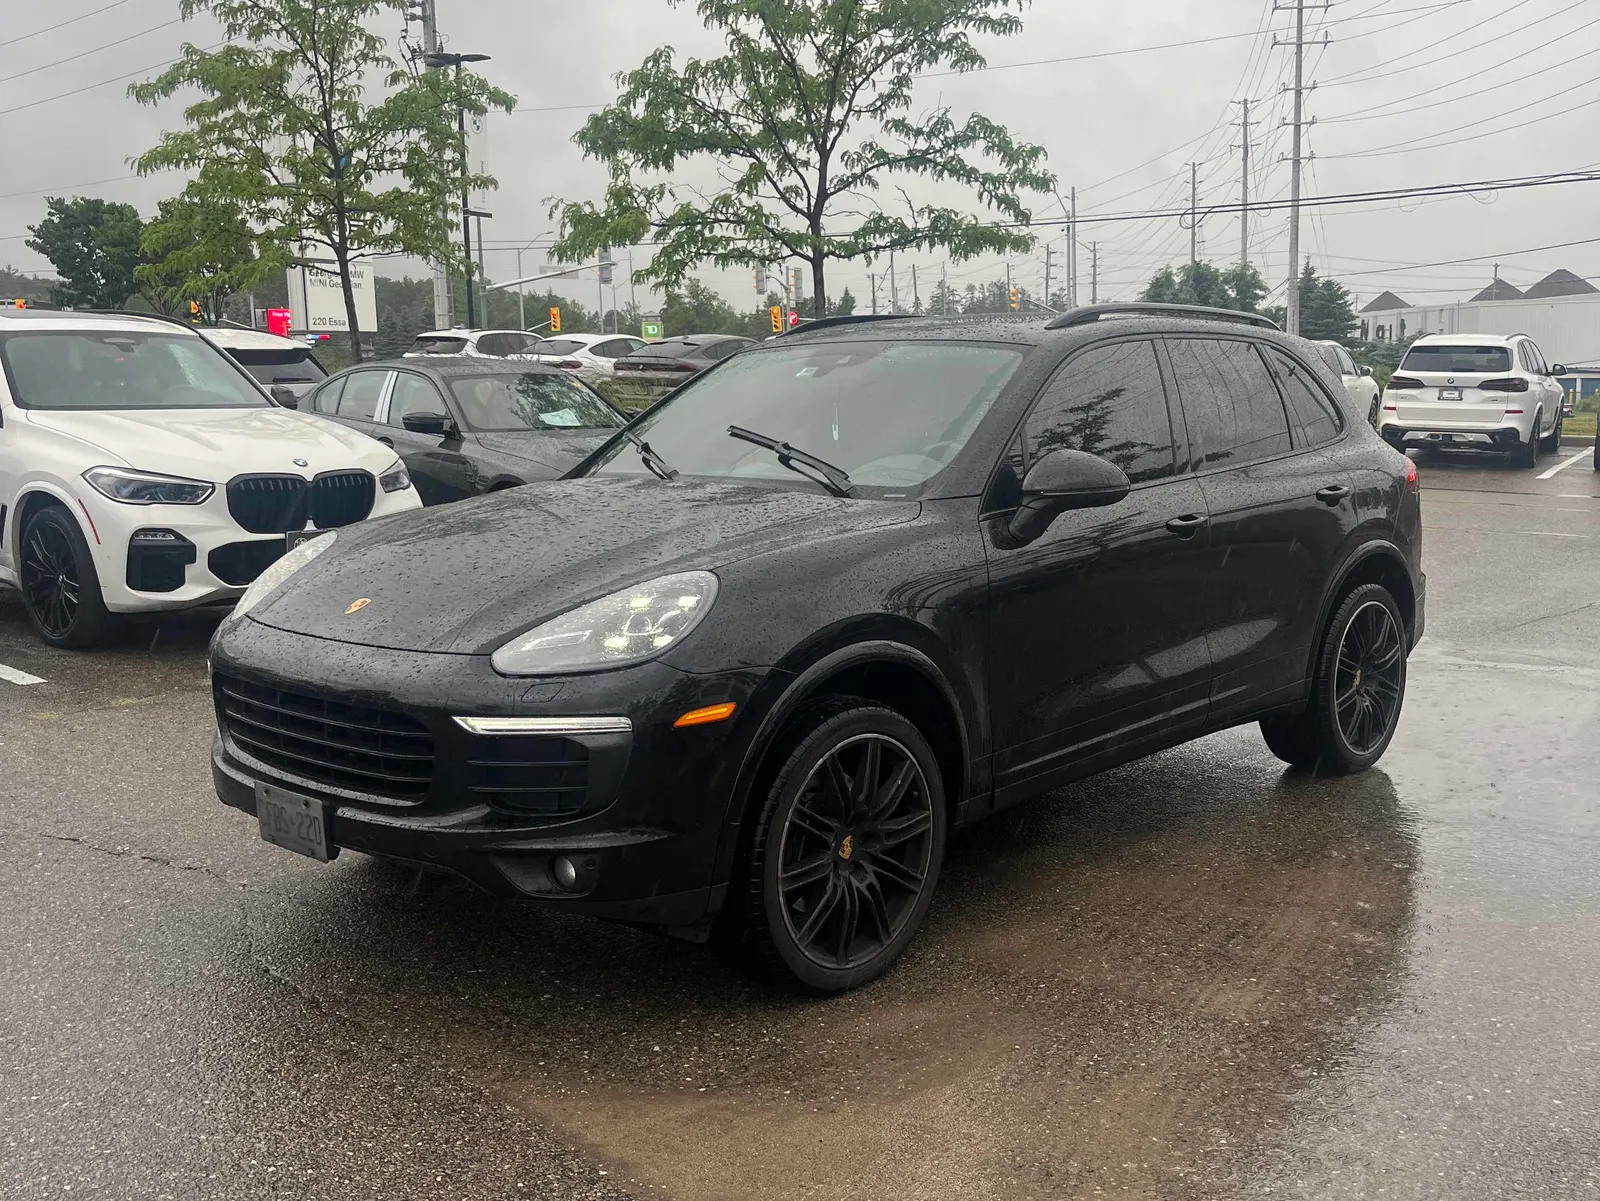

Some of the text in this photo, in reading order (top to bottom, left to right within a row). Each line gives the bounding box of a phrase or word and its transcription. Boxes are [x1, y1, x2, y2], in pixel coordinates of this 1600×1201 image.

[350, 270, 364, 279] MW
[309, 279, 362, 288] MINI Geoian
[312, 317, 346, 326] 220 Essa
[645, 325, 658, 334] TD
